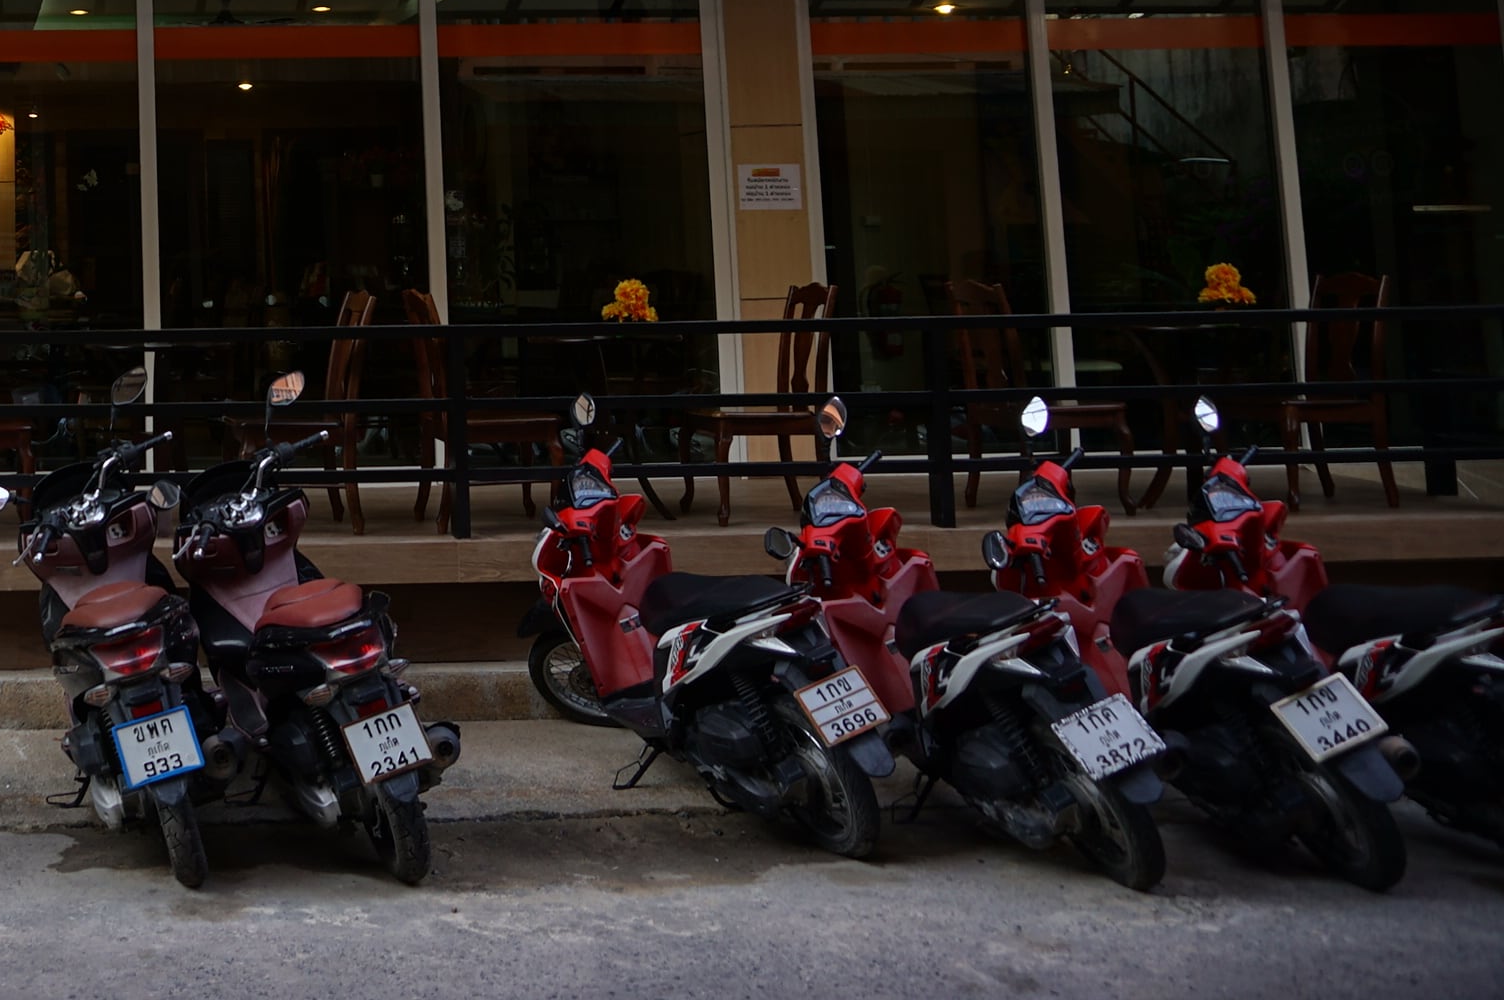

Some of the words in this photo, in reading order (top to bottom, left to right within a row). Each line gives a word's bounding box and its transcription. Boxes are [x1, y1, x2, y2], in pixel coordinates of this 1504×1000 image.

[363, 713, 402, 738] 1กก
[831, 708, 877, 738] 3696
[1317, 718, 1370, 751] 3440
[143, 753, 183, 777] 933
[371, 746, 420, 777] 2341
[1096, 738, 1146, 770] 3872
